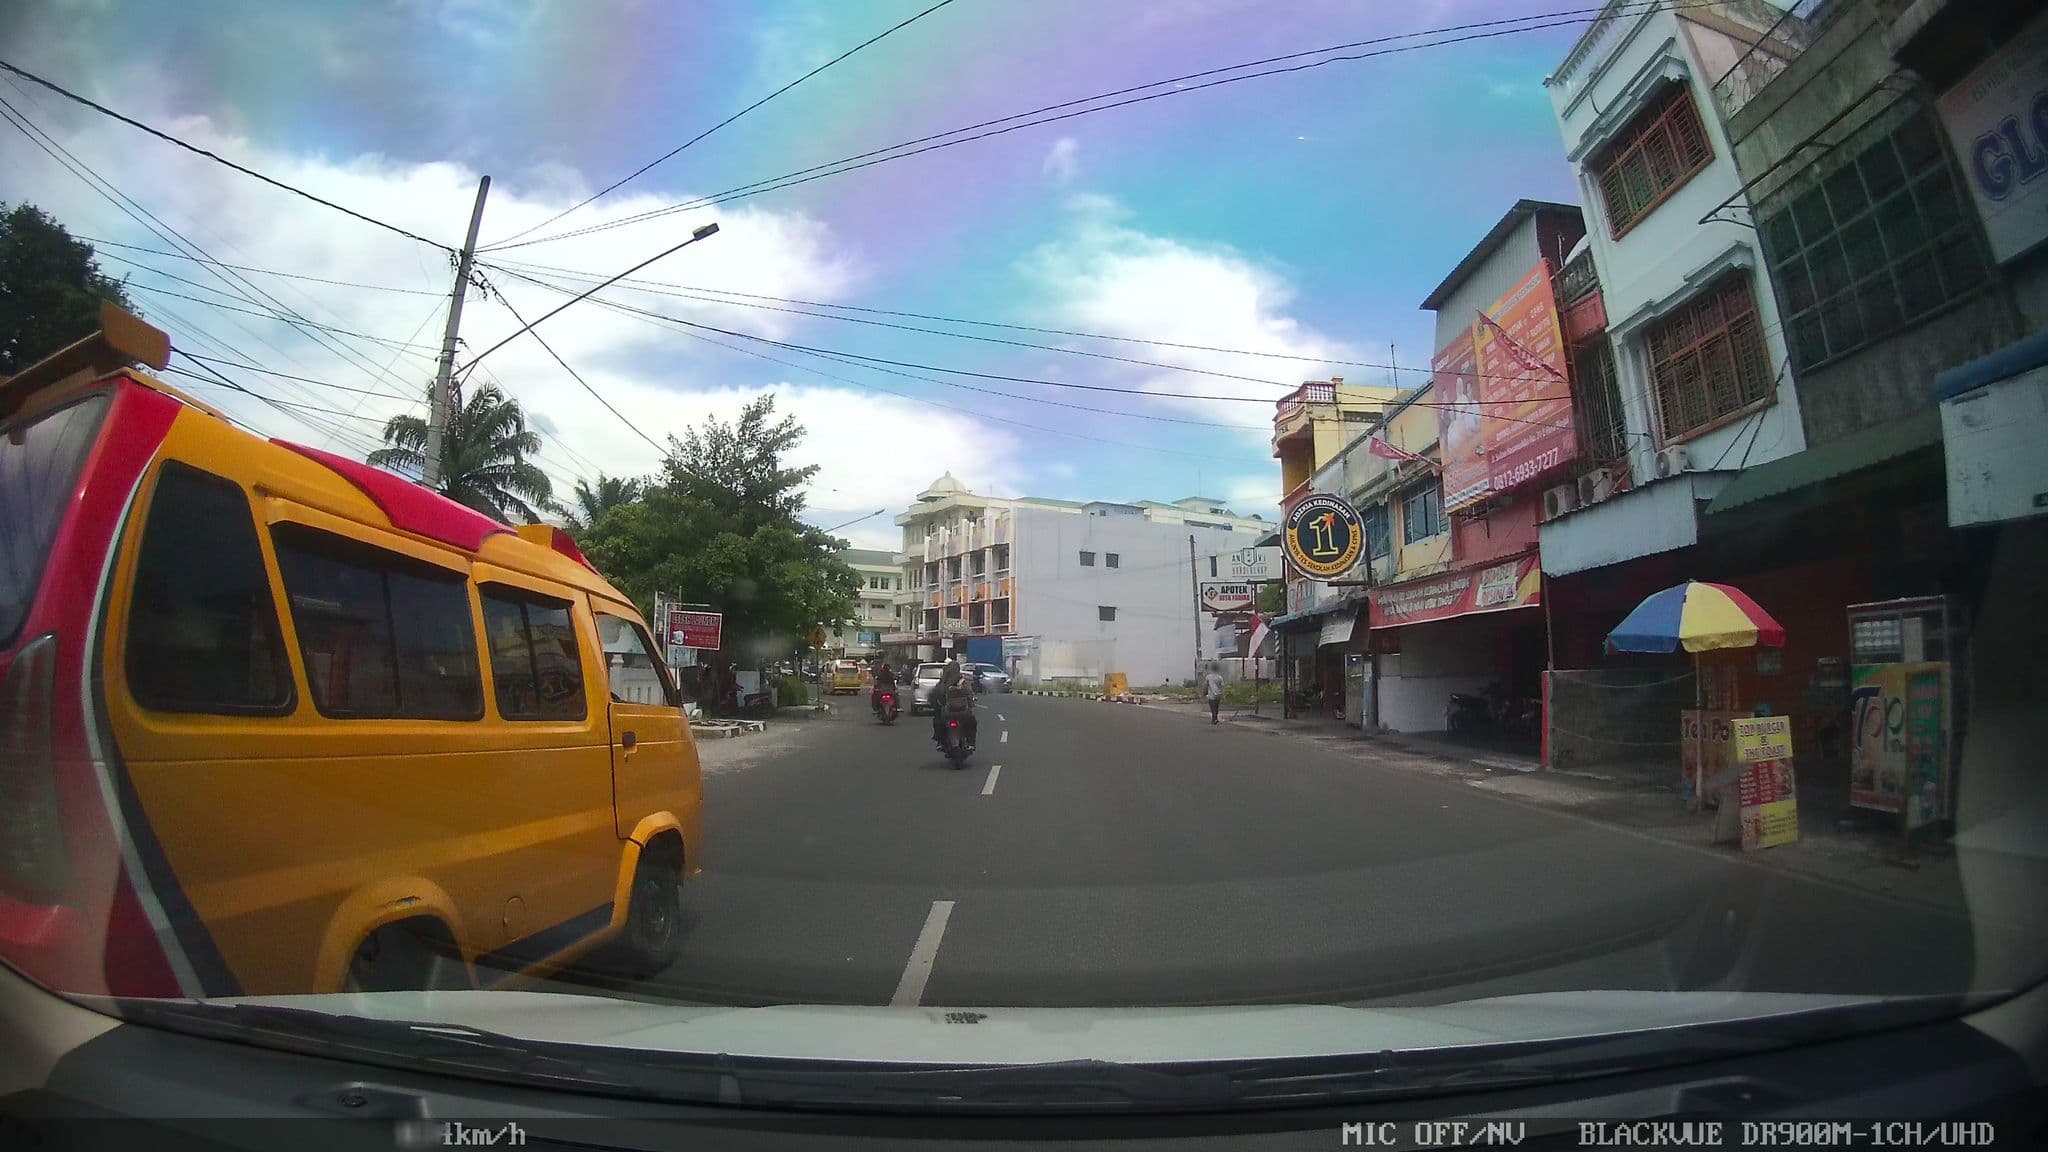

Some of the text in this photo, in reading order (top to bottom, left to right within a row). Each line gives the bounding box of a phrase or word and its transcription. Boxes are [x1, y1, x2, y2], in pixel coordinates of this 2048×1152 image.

[1313, 499, 1351, 519] KEDINASAN
[1220, 585, 1248, 594] APOTEK
[1711, 718, 1731, 742] Po
